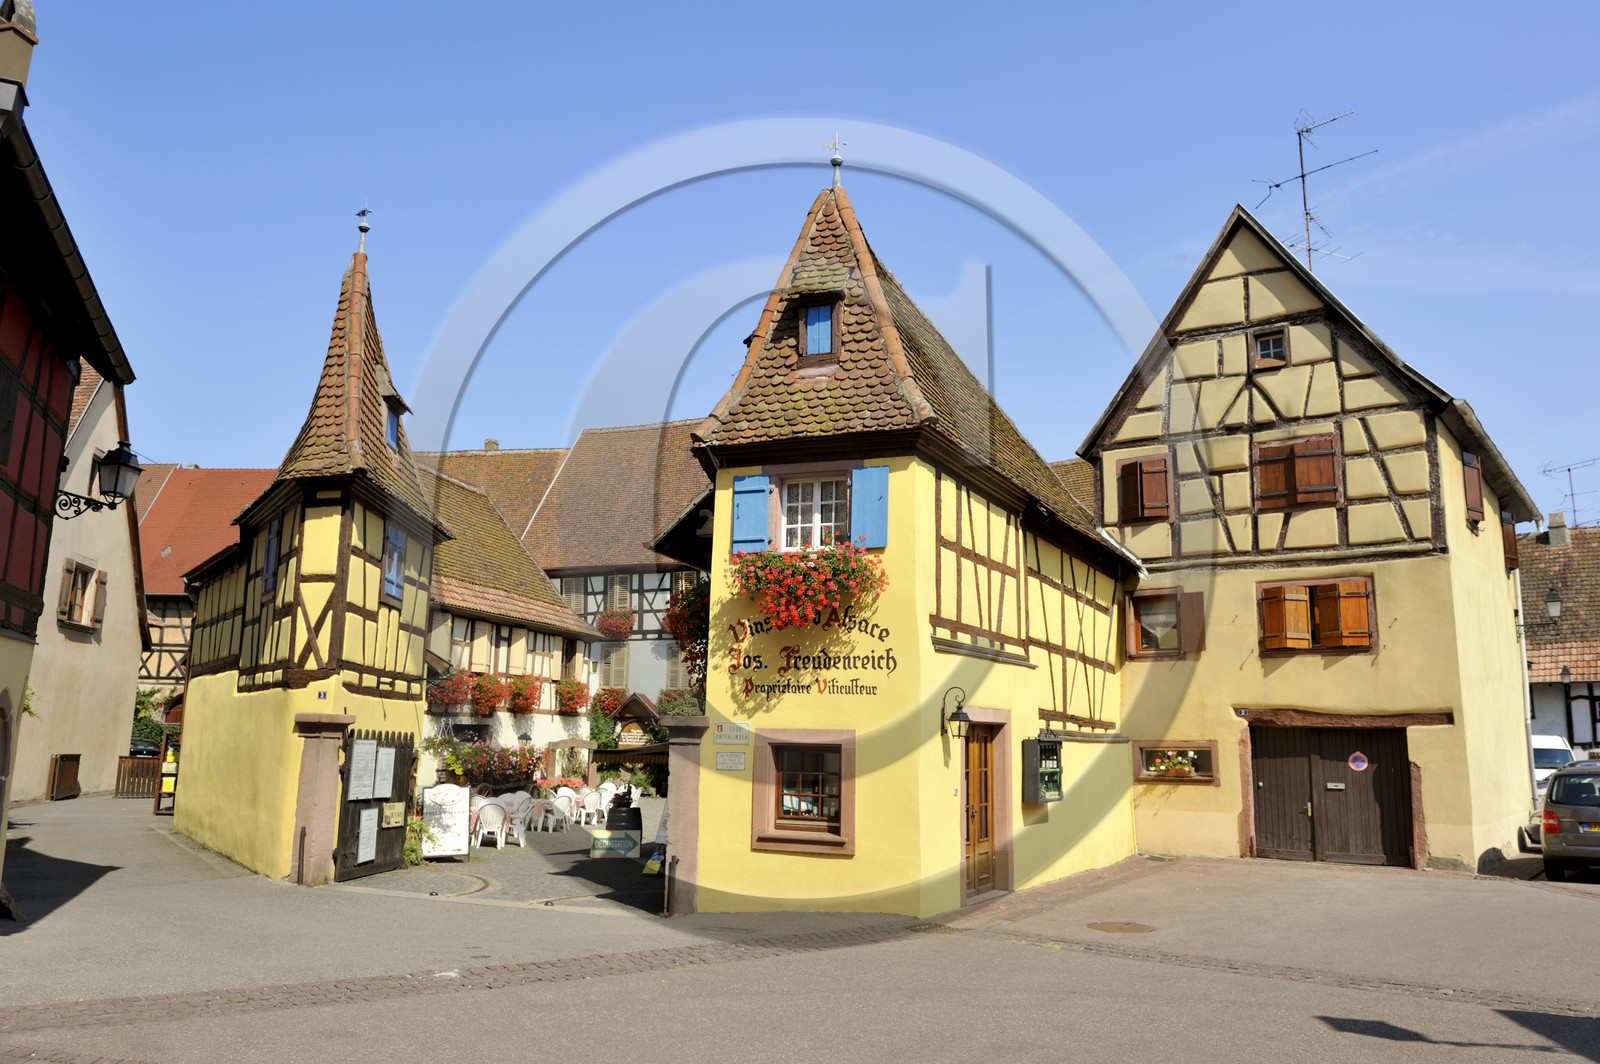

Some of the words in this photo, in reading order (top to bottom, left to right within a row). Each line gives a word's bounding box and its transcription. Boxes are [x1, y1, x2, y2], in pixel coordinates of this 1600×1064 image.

[727, 615, 773, 643] Vins
[728, 646, 768, 675] Jos.
[777, 645, 897, 679] Freudenreich
[742, 677, 812, 702] Propriétaire
[815, 678, 878, 696] Viticulteur
